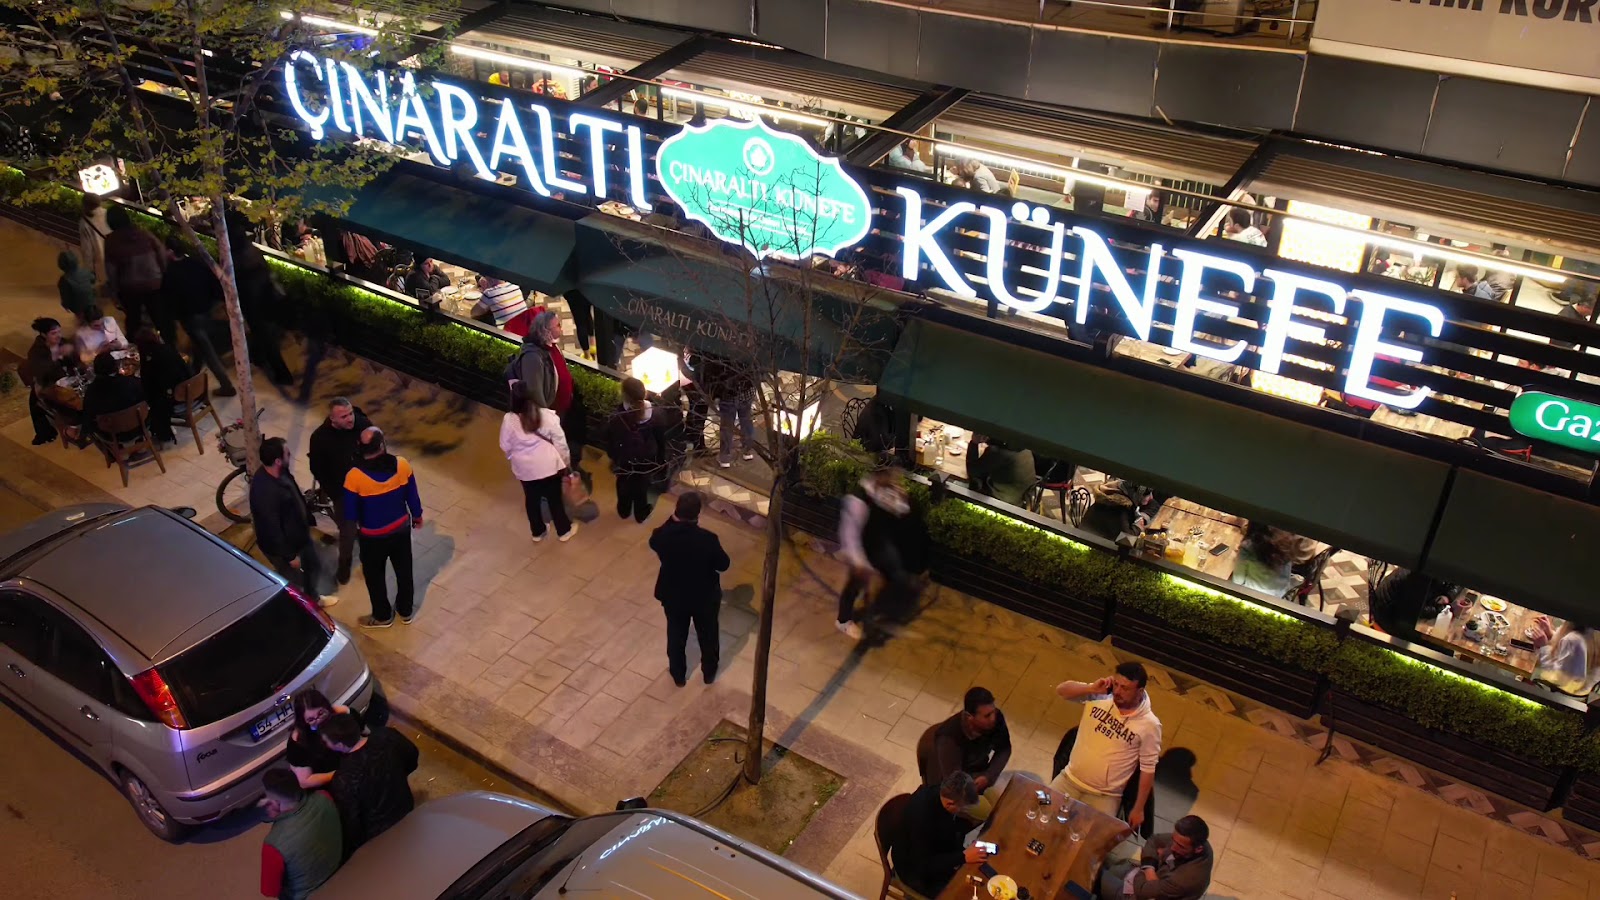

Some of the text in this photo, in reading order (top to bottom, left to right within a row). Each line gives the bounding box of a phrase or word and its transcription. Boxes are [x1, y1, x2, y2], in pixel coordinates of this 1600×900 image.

[669, 159, 768, 203] ÇINARALTI
[775, 182, 856, 225] KÜNEFE
[284, 50, 1446, 410] ÇINARALTI KÜNEFE
[627, 296, 766, 350] ÇINARALTI KÜNEF
[256, 718, 273, 734] 54
